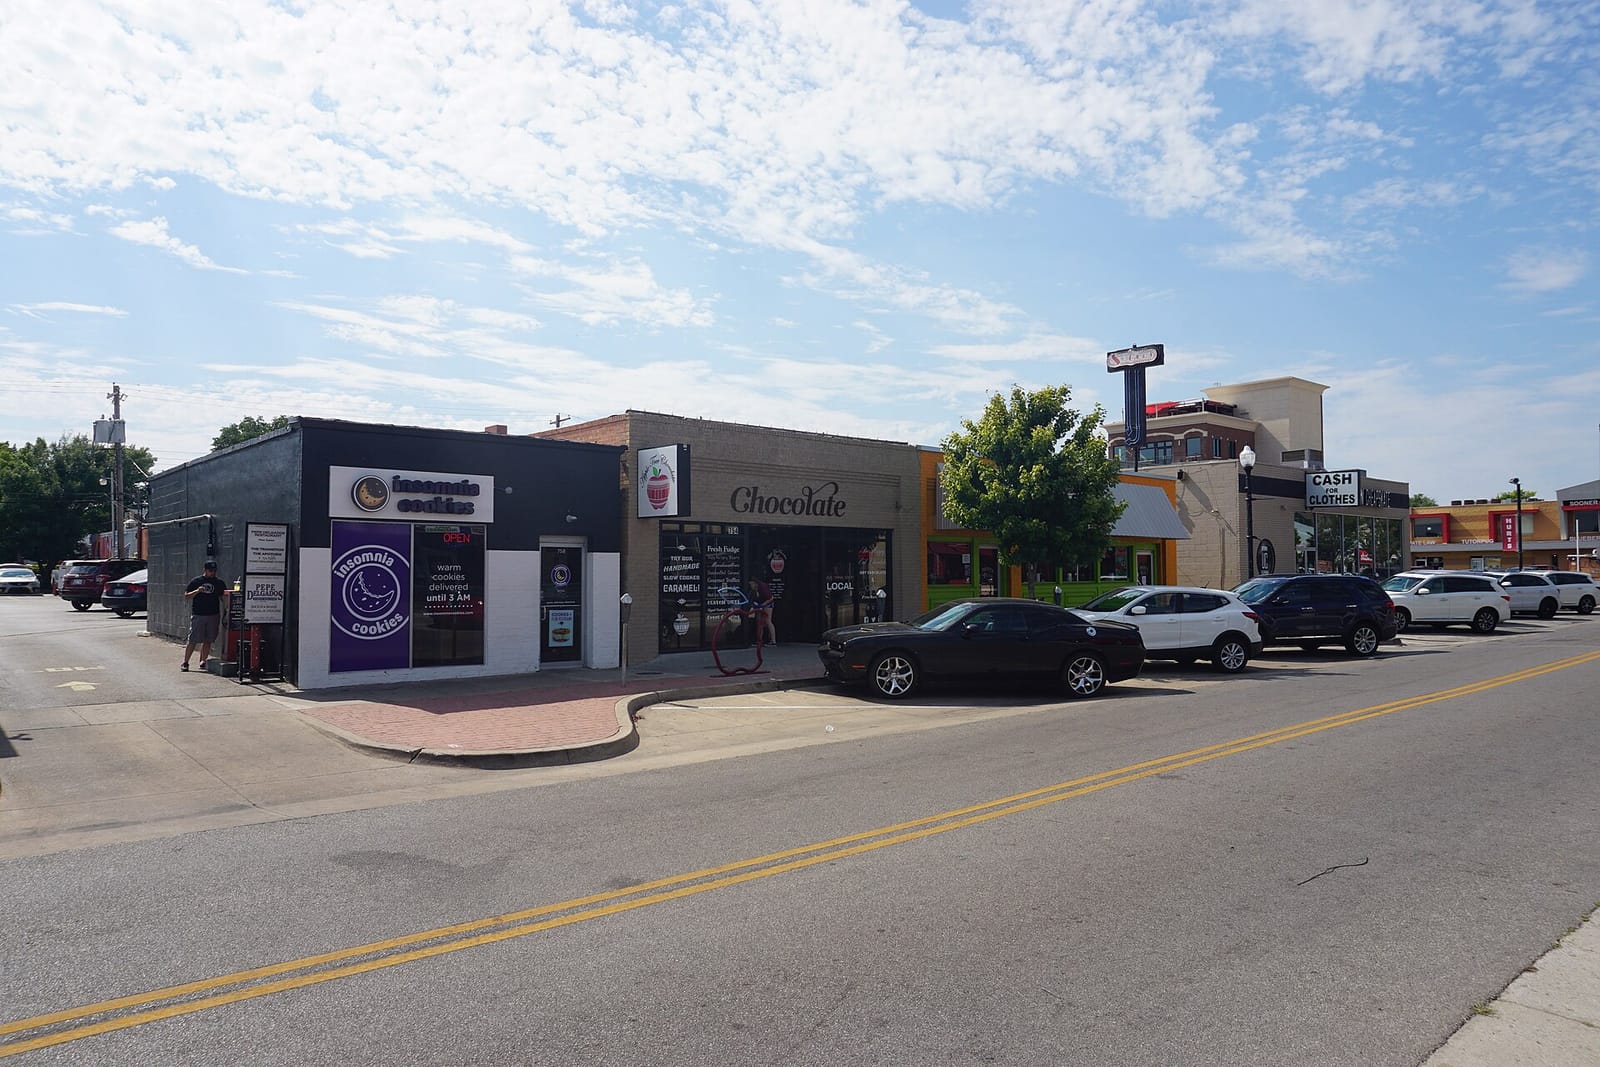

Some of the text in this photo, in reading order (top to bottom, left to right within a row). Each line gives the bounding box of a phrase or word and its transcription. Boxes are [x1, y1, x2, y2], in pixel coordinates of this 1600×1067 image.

[392, 475, 480, 496] insomnia
[730, 481, 847, 517] Chocolate
[1309, 494, 1355, 505] CLOTHES
[397, 497, 475, 515] cookies
[442, 532, 471, 544] OPEN
[1505, 518, 1513, 549] HURTS
[723, 545, 740, 554] Fudge
[334, 552, 395, 579] insomnia
[437, 564, 462, 572] warm
[663, 562, 701, 573] HANDMADE
[432, 573, 465, 581] cookies
[255, 583, 276, 591] PEPE
[429, 583, 469, 592] delivered
[826, 582, 854, 591] LOCAL
[247, 590, 284, 601] DELGADOS
[426, 593, 471, 602] until 3 AM
[352, 612, 404, 635] cookies
